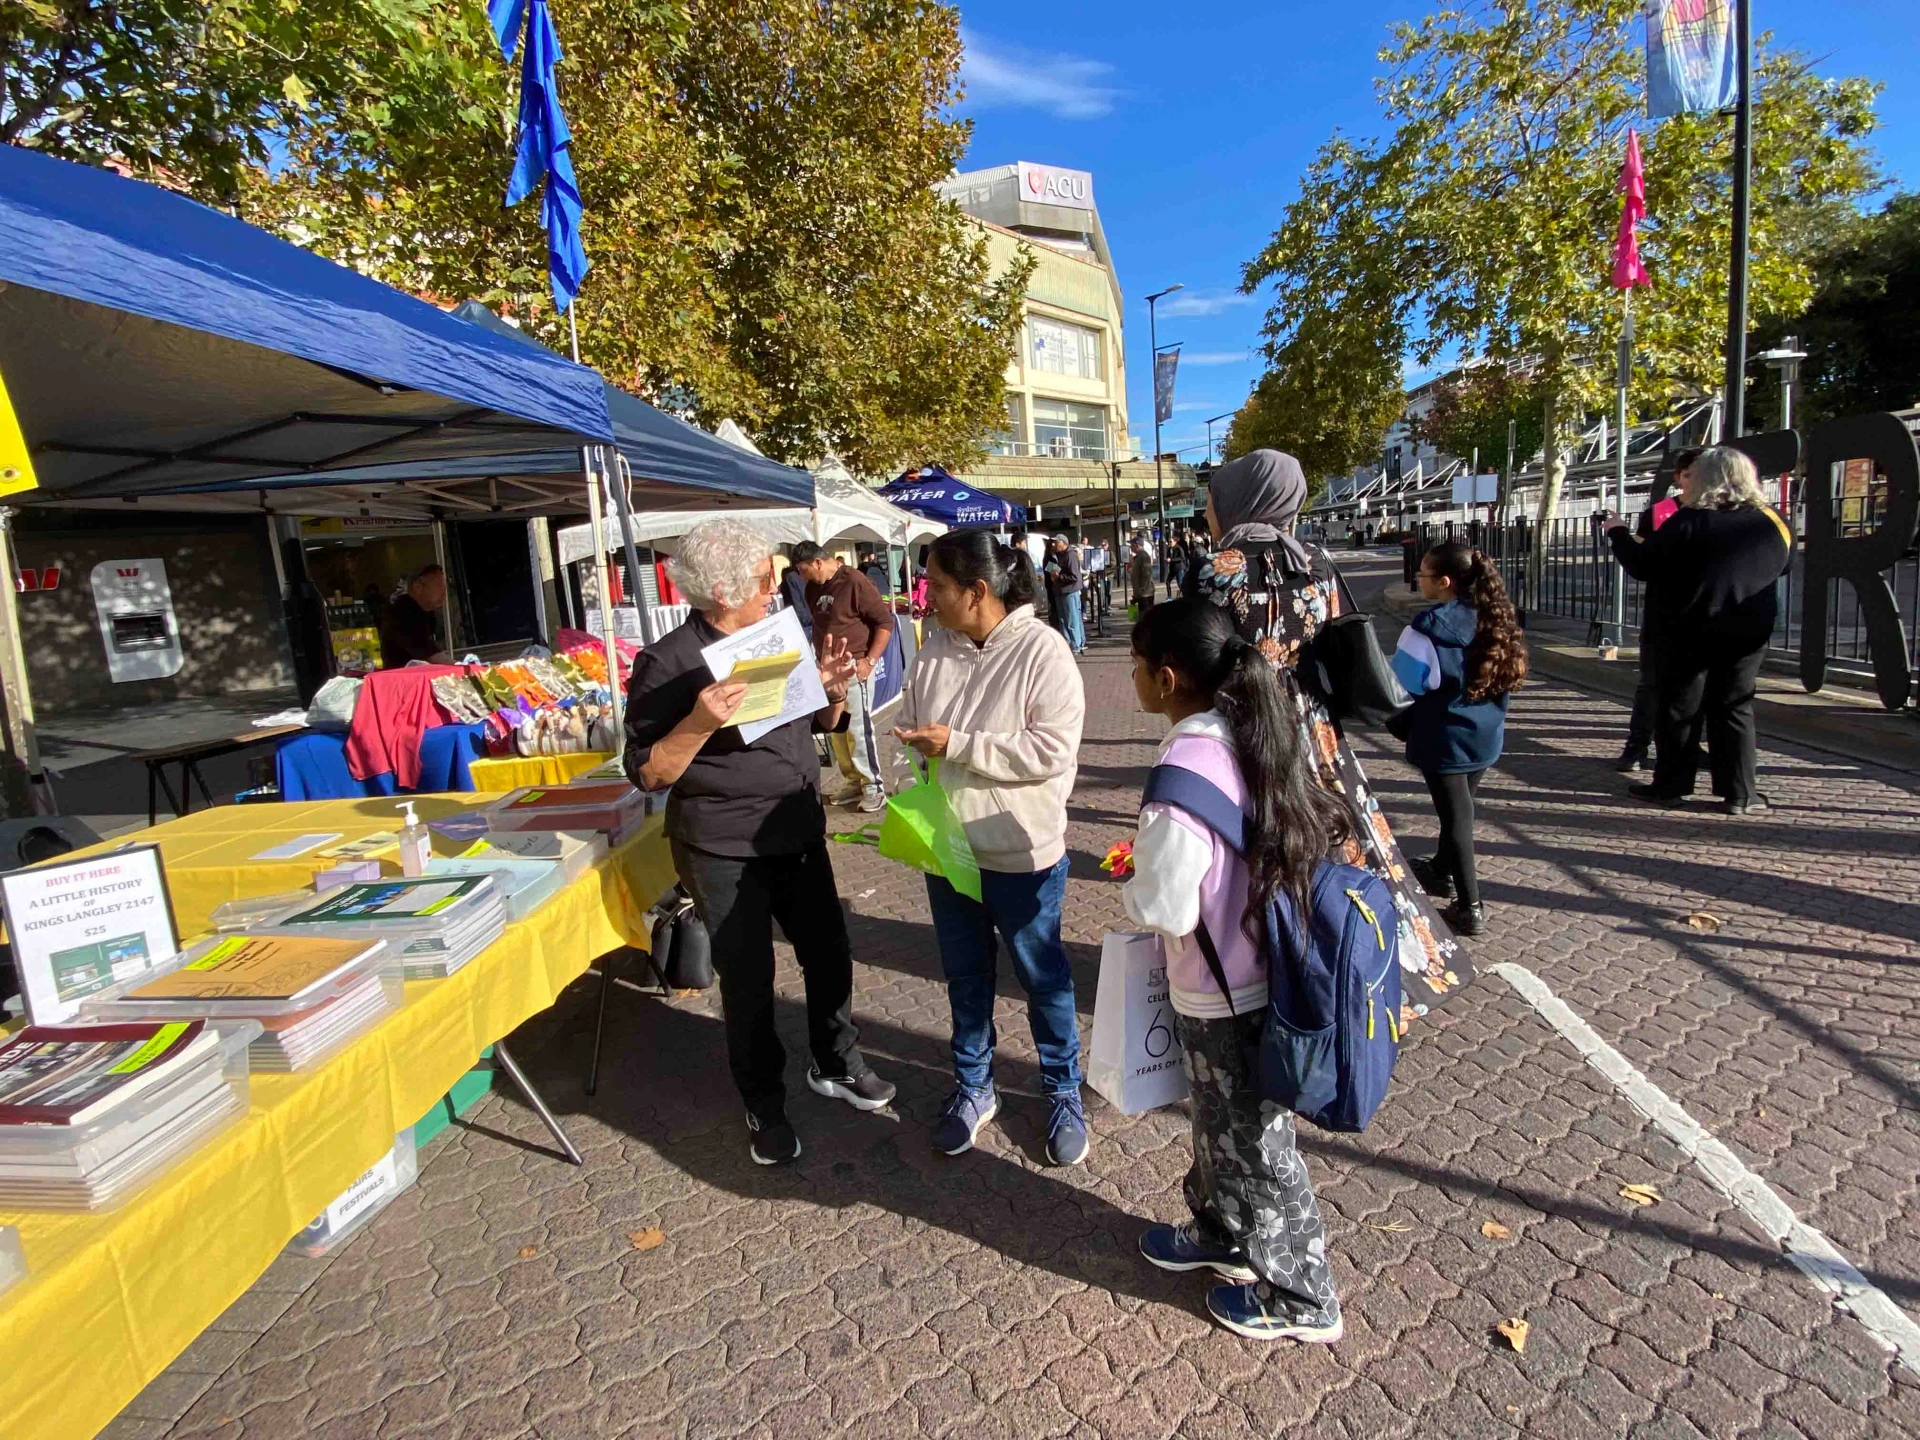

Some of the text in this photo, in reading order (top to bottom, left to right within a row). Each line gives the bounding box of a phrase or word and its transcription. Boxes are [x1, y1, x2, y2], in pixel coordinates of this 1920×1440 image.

[1044, 175, 1085, 200] ACU
[957, 506, 982, 514] Sydney
[957, 510, 999, 523] WATER
[45, 865, 122, 888] BUY IT HERE
[29, 878, 143, 909] A LITTLE HISTORY
[83, 899, 96, 907] OF
[24, 896, 155, 932] KINGS LANGLEY 2147
[1135, 1062, 1163, 1077] YEARS
[1165, 1059, 1178, 1070] OF
[339, 1176, 385, 1215] FESTIVALS
